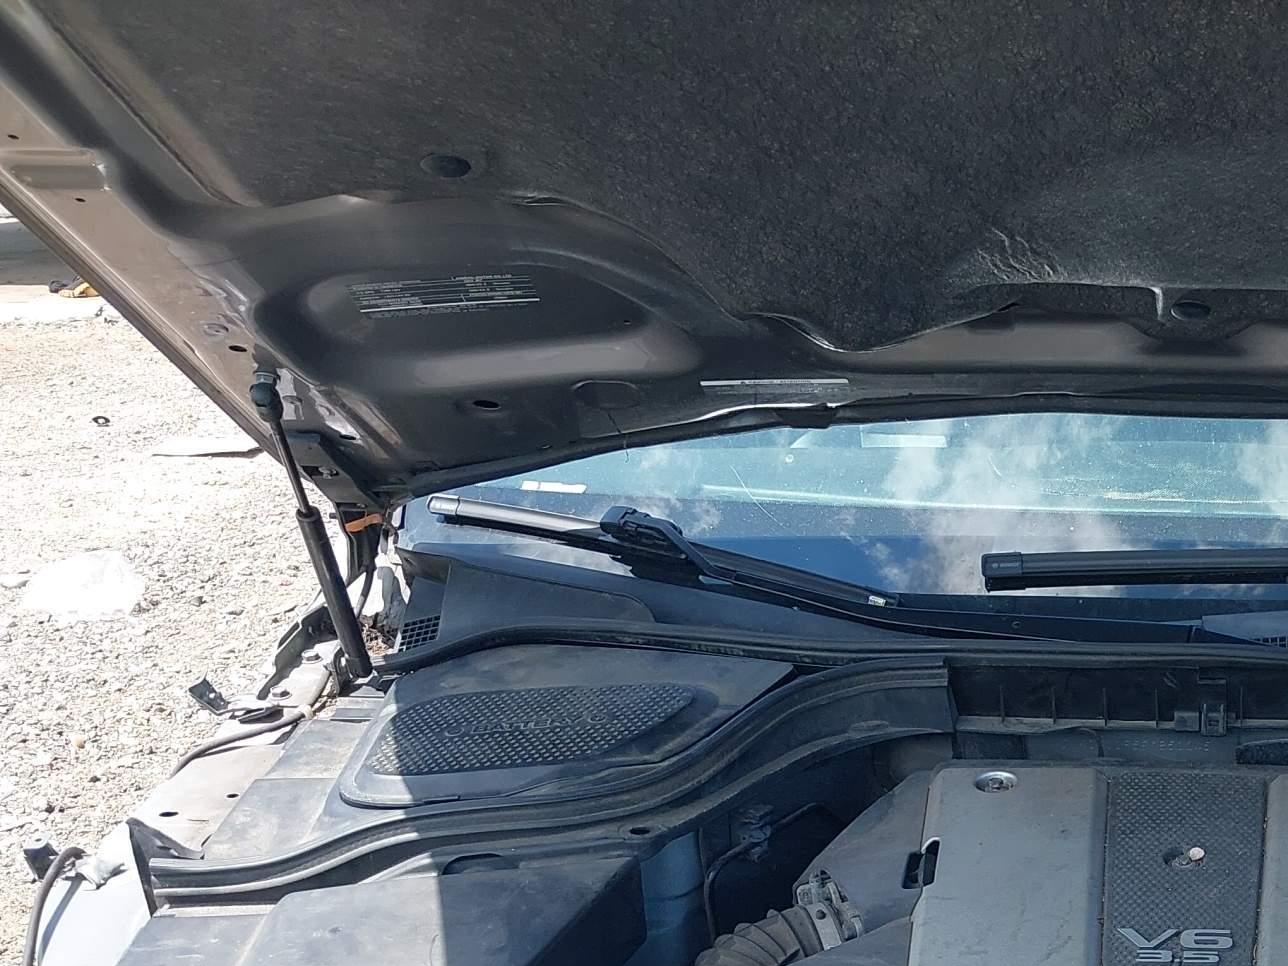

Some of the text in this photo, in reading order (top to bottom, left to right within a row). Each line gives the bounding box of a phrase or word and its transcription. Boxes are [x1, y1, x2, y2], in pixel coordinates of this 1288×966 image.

[470, 715, 584, 734] BATTERY
[1116, 928, 1234, 949] V6
[1135, 950, 1220, 964] 3.5
